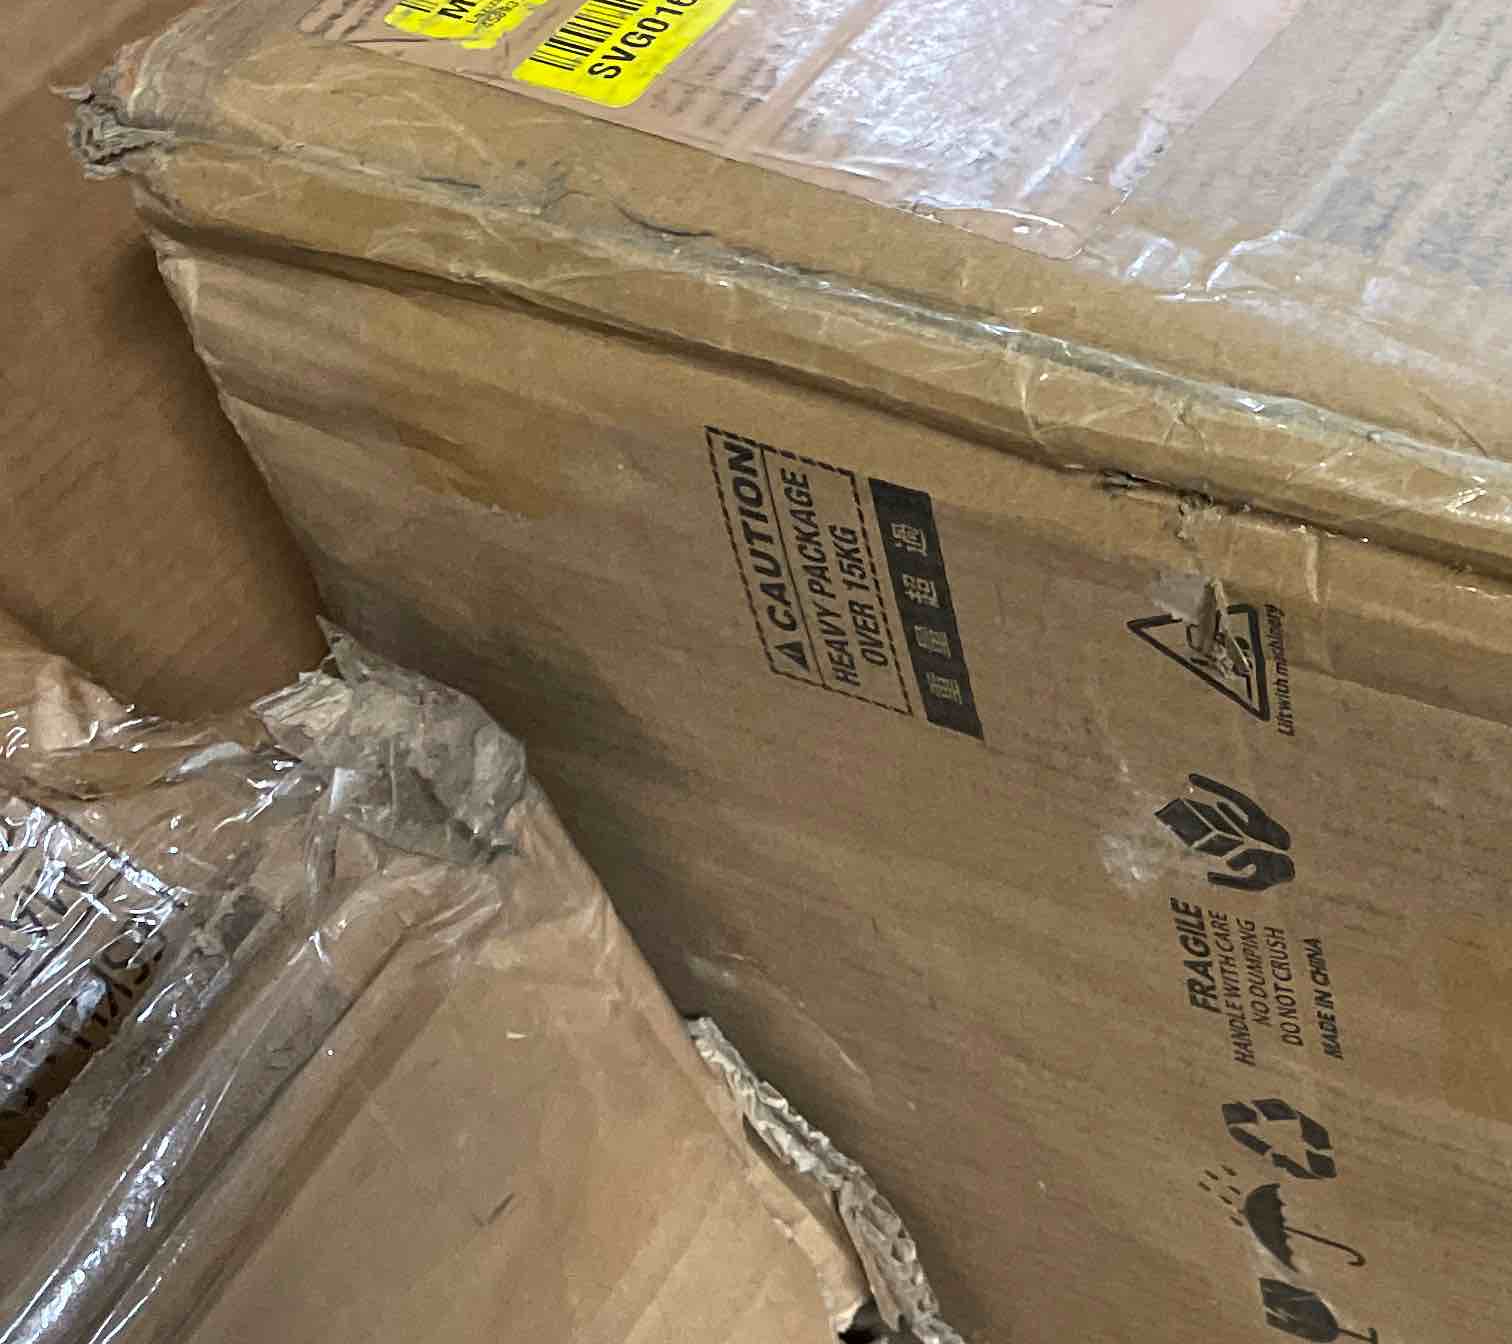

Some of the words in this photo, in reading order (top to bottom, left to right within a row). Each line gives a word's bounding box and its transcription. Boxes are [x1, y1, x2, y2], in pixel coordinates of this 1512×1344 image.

[723, 440, 798, 632] CAUTION
[781, 468, 836, 600] PACKAGE
[828, 523, 871, 592] 15KG
[816, 601, 862, 687] HEAVY
[848, 599, 889, 668] OVER
[1170, 896, 1223, 1014] FRAGILE
[1208, 909, 1236, 953] CARE
[1236, 917, 1269, 1000] DUMPING
[1263, 926, 1293, 982] CRUSH
[1218, 954, 1241, 999] WITH
[1303, 937, 1331, 987] CHINA
[1250, 1000, 1273, 1027] NO
[1273, 982, 1297, 1020] NOT
[1313, 988, 1335, 1010] IN
[1224, 999, 1257, 1067] HANDLE
[1279, 1021, 1305, 1047] DO
[1316, 1010, 1345, 1060] MADE
